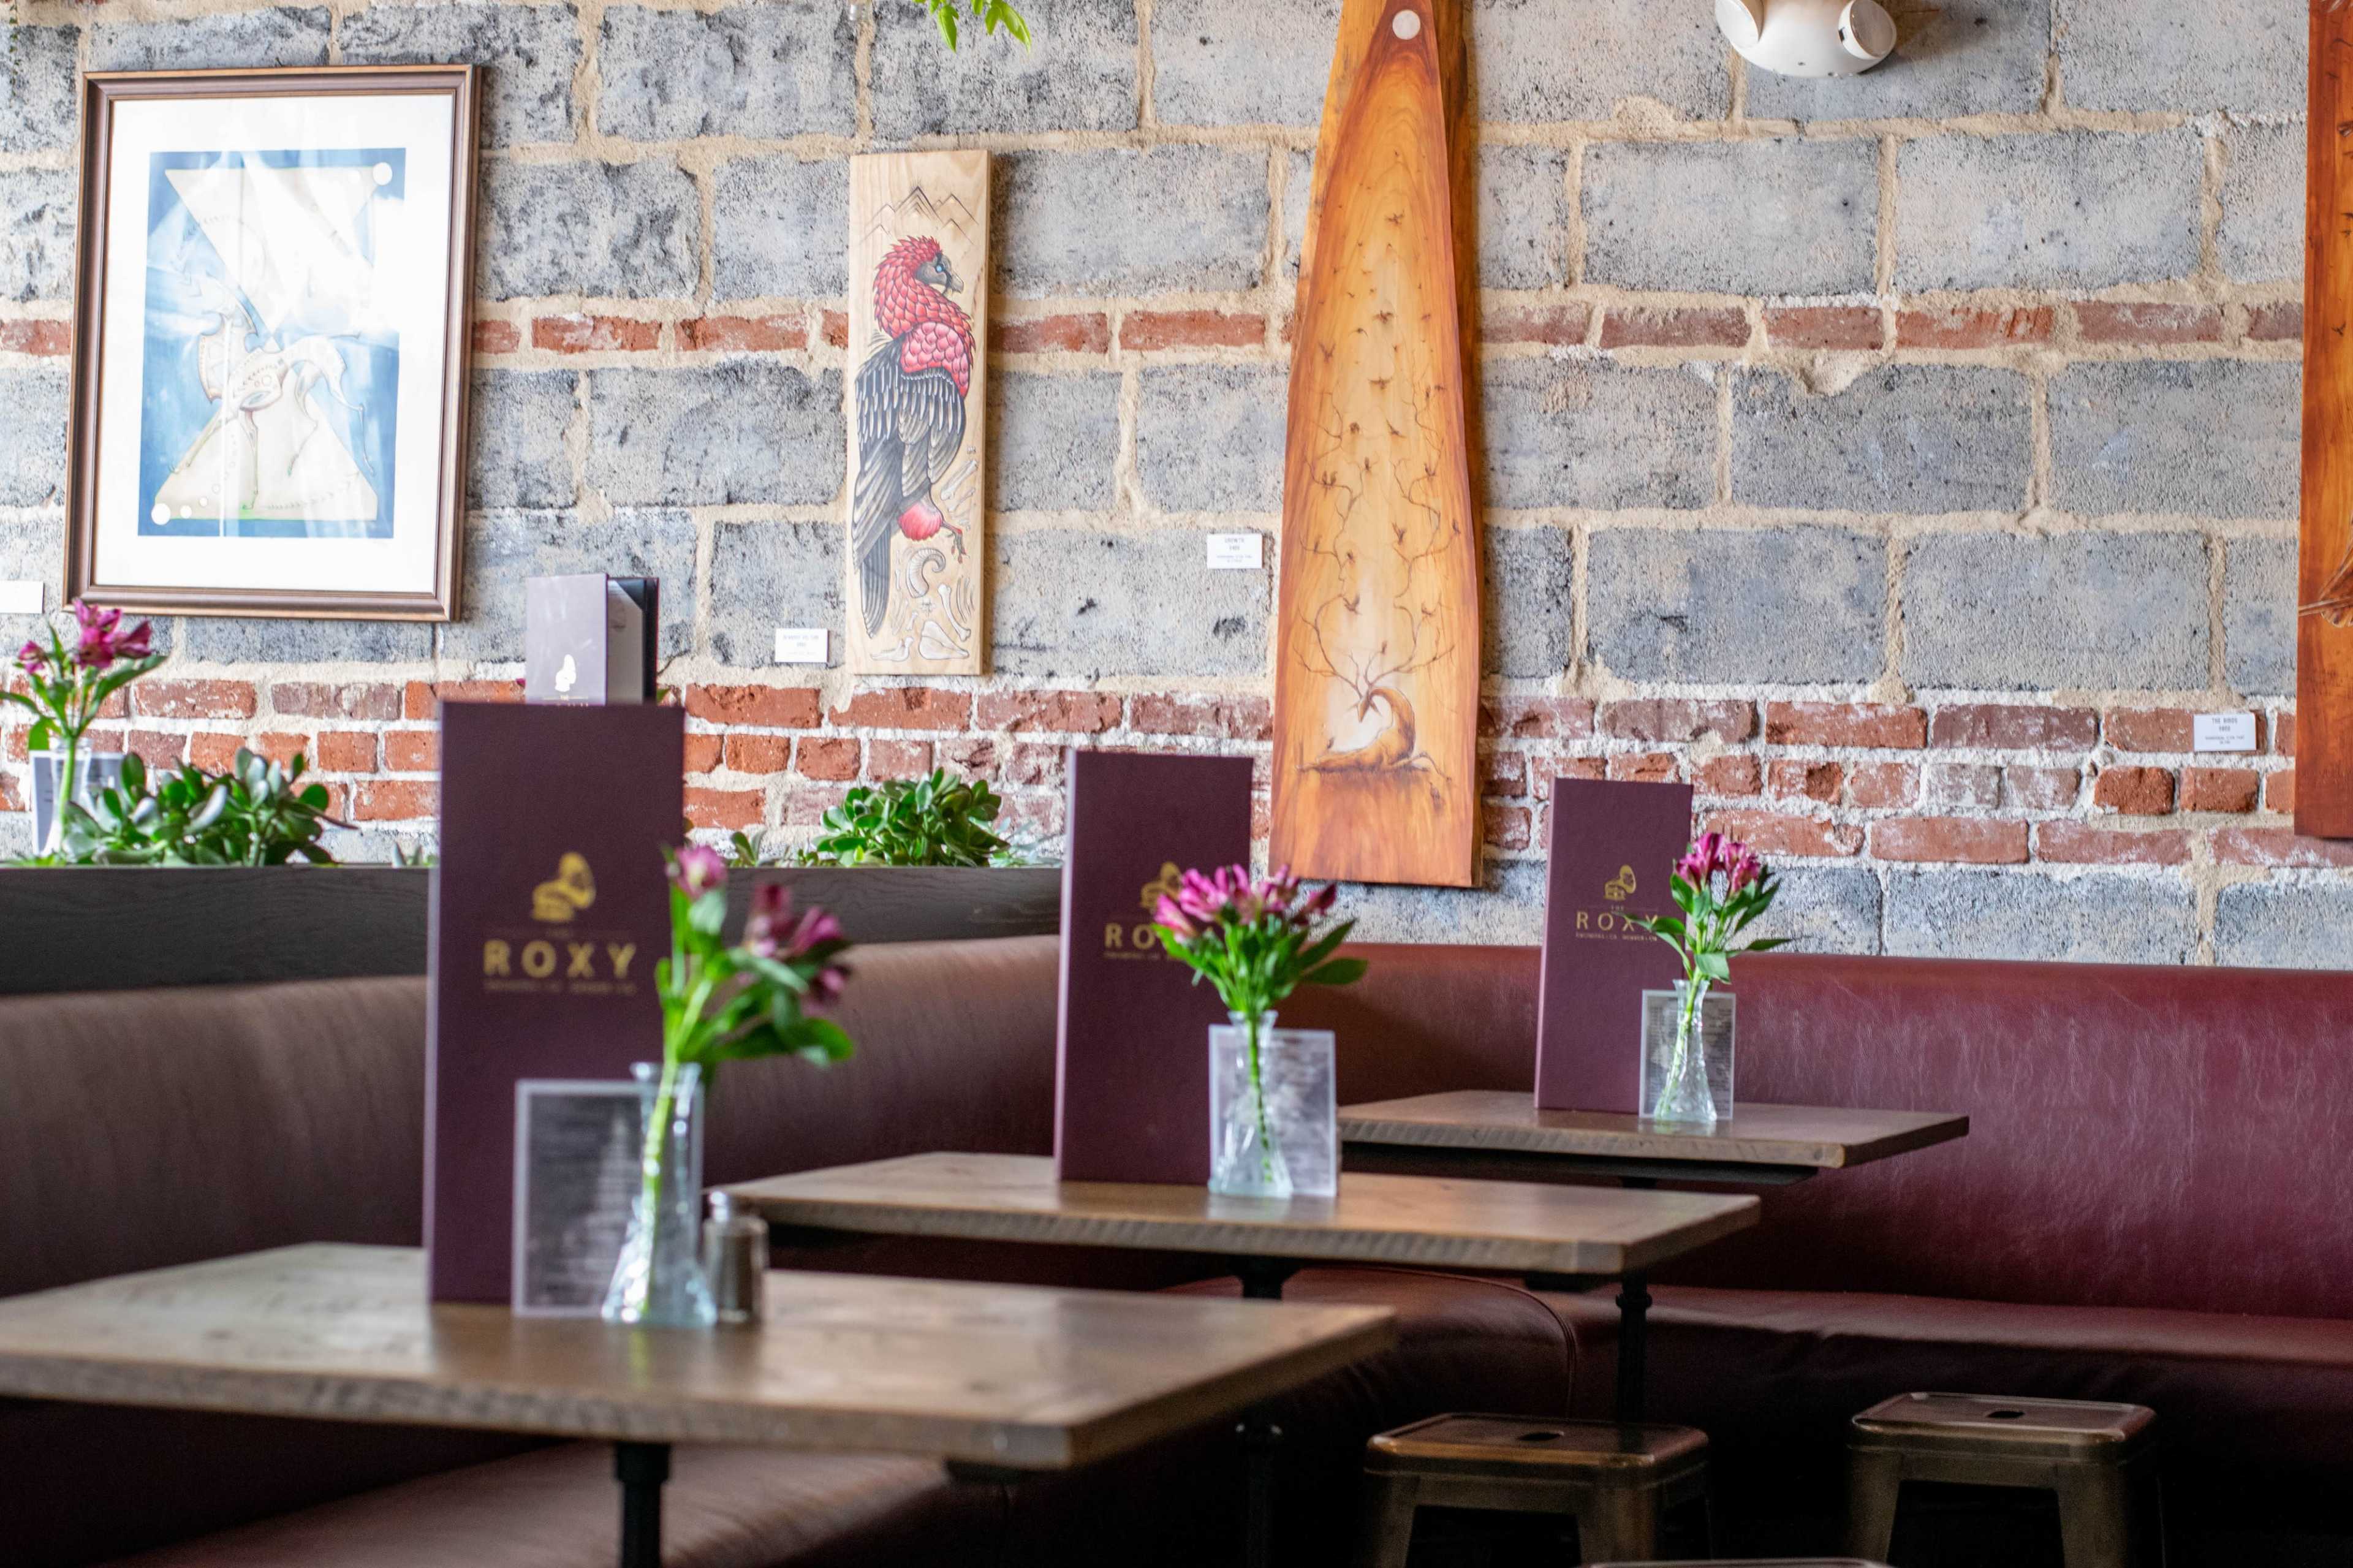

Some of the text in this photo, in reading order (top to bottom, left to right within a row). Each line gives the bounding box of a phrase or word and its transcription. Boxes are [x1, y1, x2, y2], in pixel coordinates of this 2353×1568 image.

[1104, 922, 1156, 950] RO
[1576, 911, 1658, 933] ROXY
[483, 939, 637, 979] ROXY
